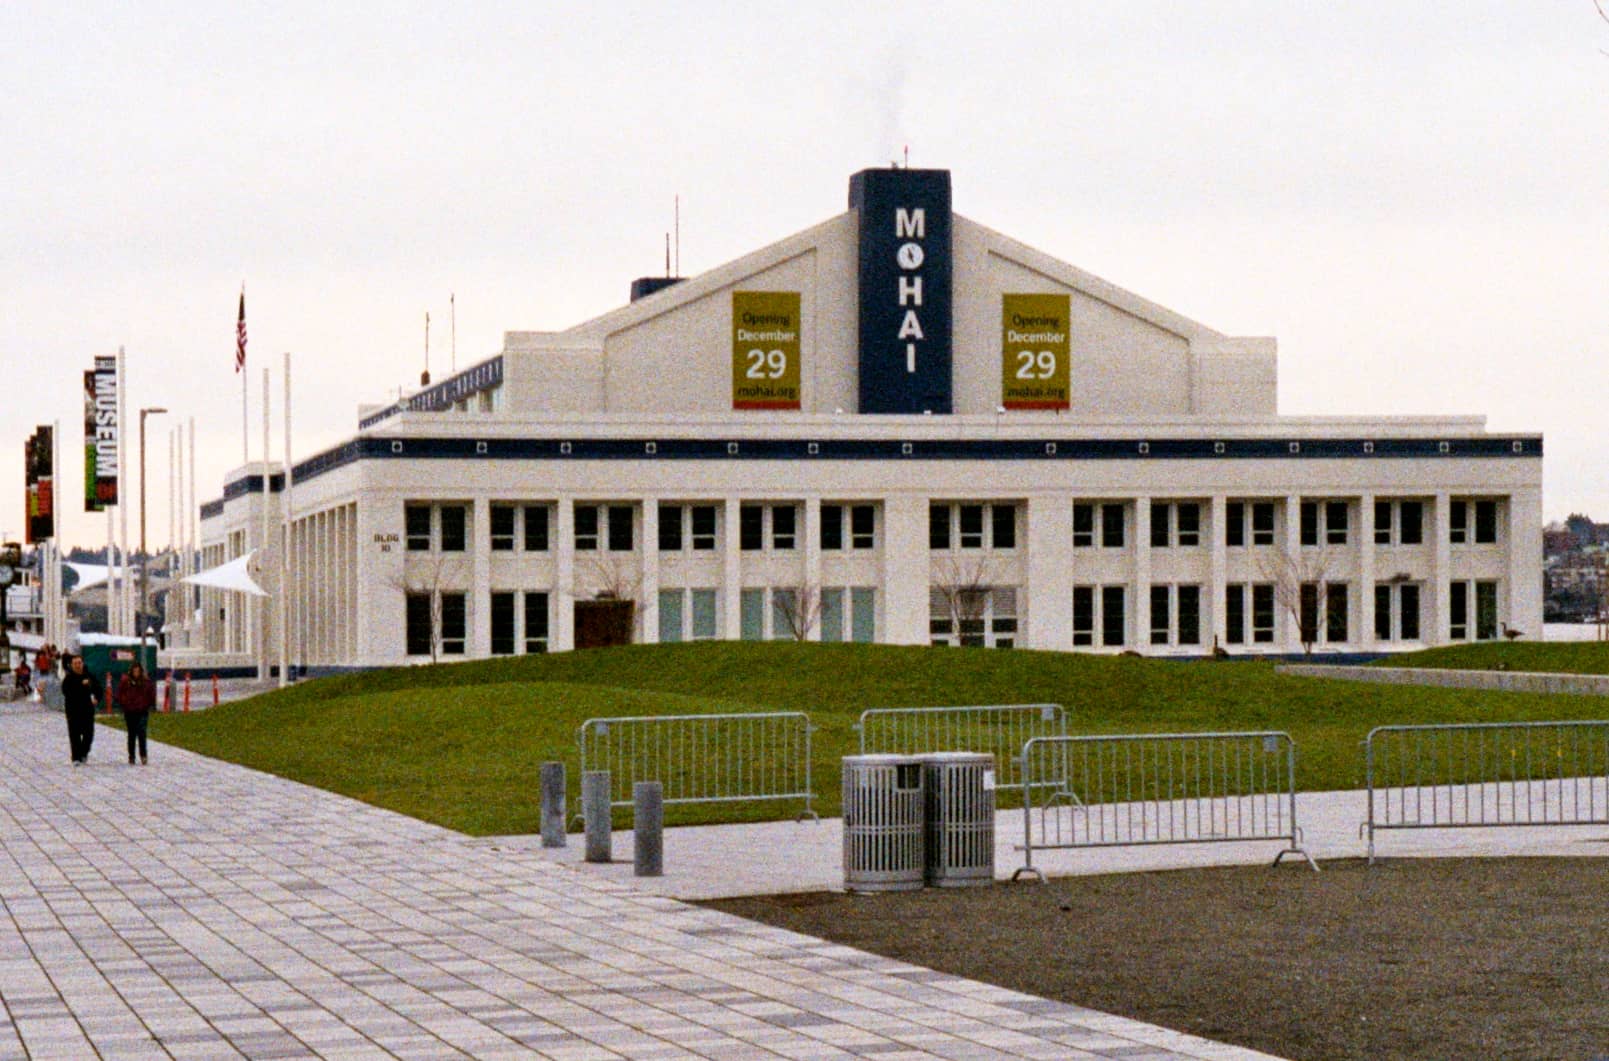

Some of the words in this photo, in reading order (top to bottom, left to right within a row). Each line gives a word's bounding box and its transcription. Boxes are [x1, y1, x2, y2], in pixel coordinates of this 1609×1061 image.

[895, 207, 926, 373] MOHAI
[742, 312, 790, 327] Opening
[1012, 313, 1060, 329] Opening
[738, 328, 797, 342] December
[1007, 329, 1065, 343] December
[746, 348, 787, 379] 29
[1016, 350, 1056, 380] 29
[738, 384, 797, 399] mohai.org
[1007, 386, 1065, 400] mohai.org
[95, 374, 118, 477] MUSEUM
